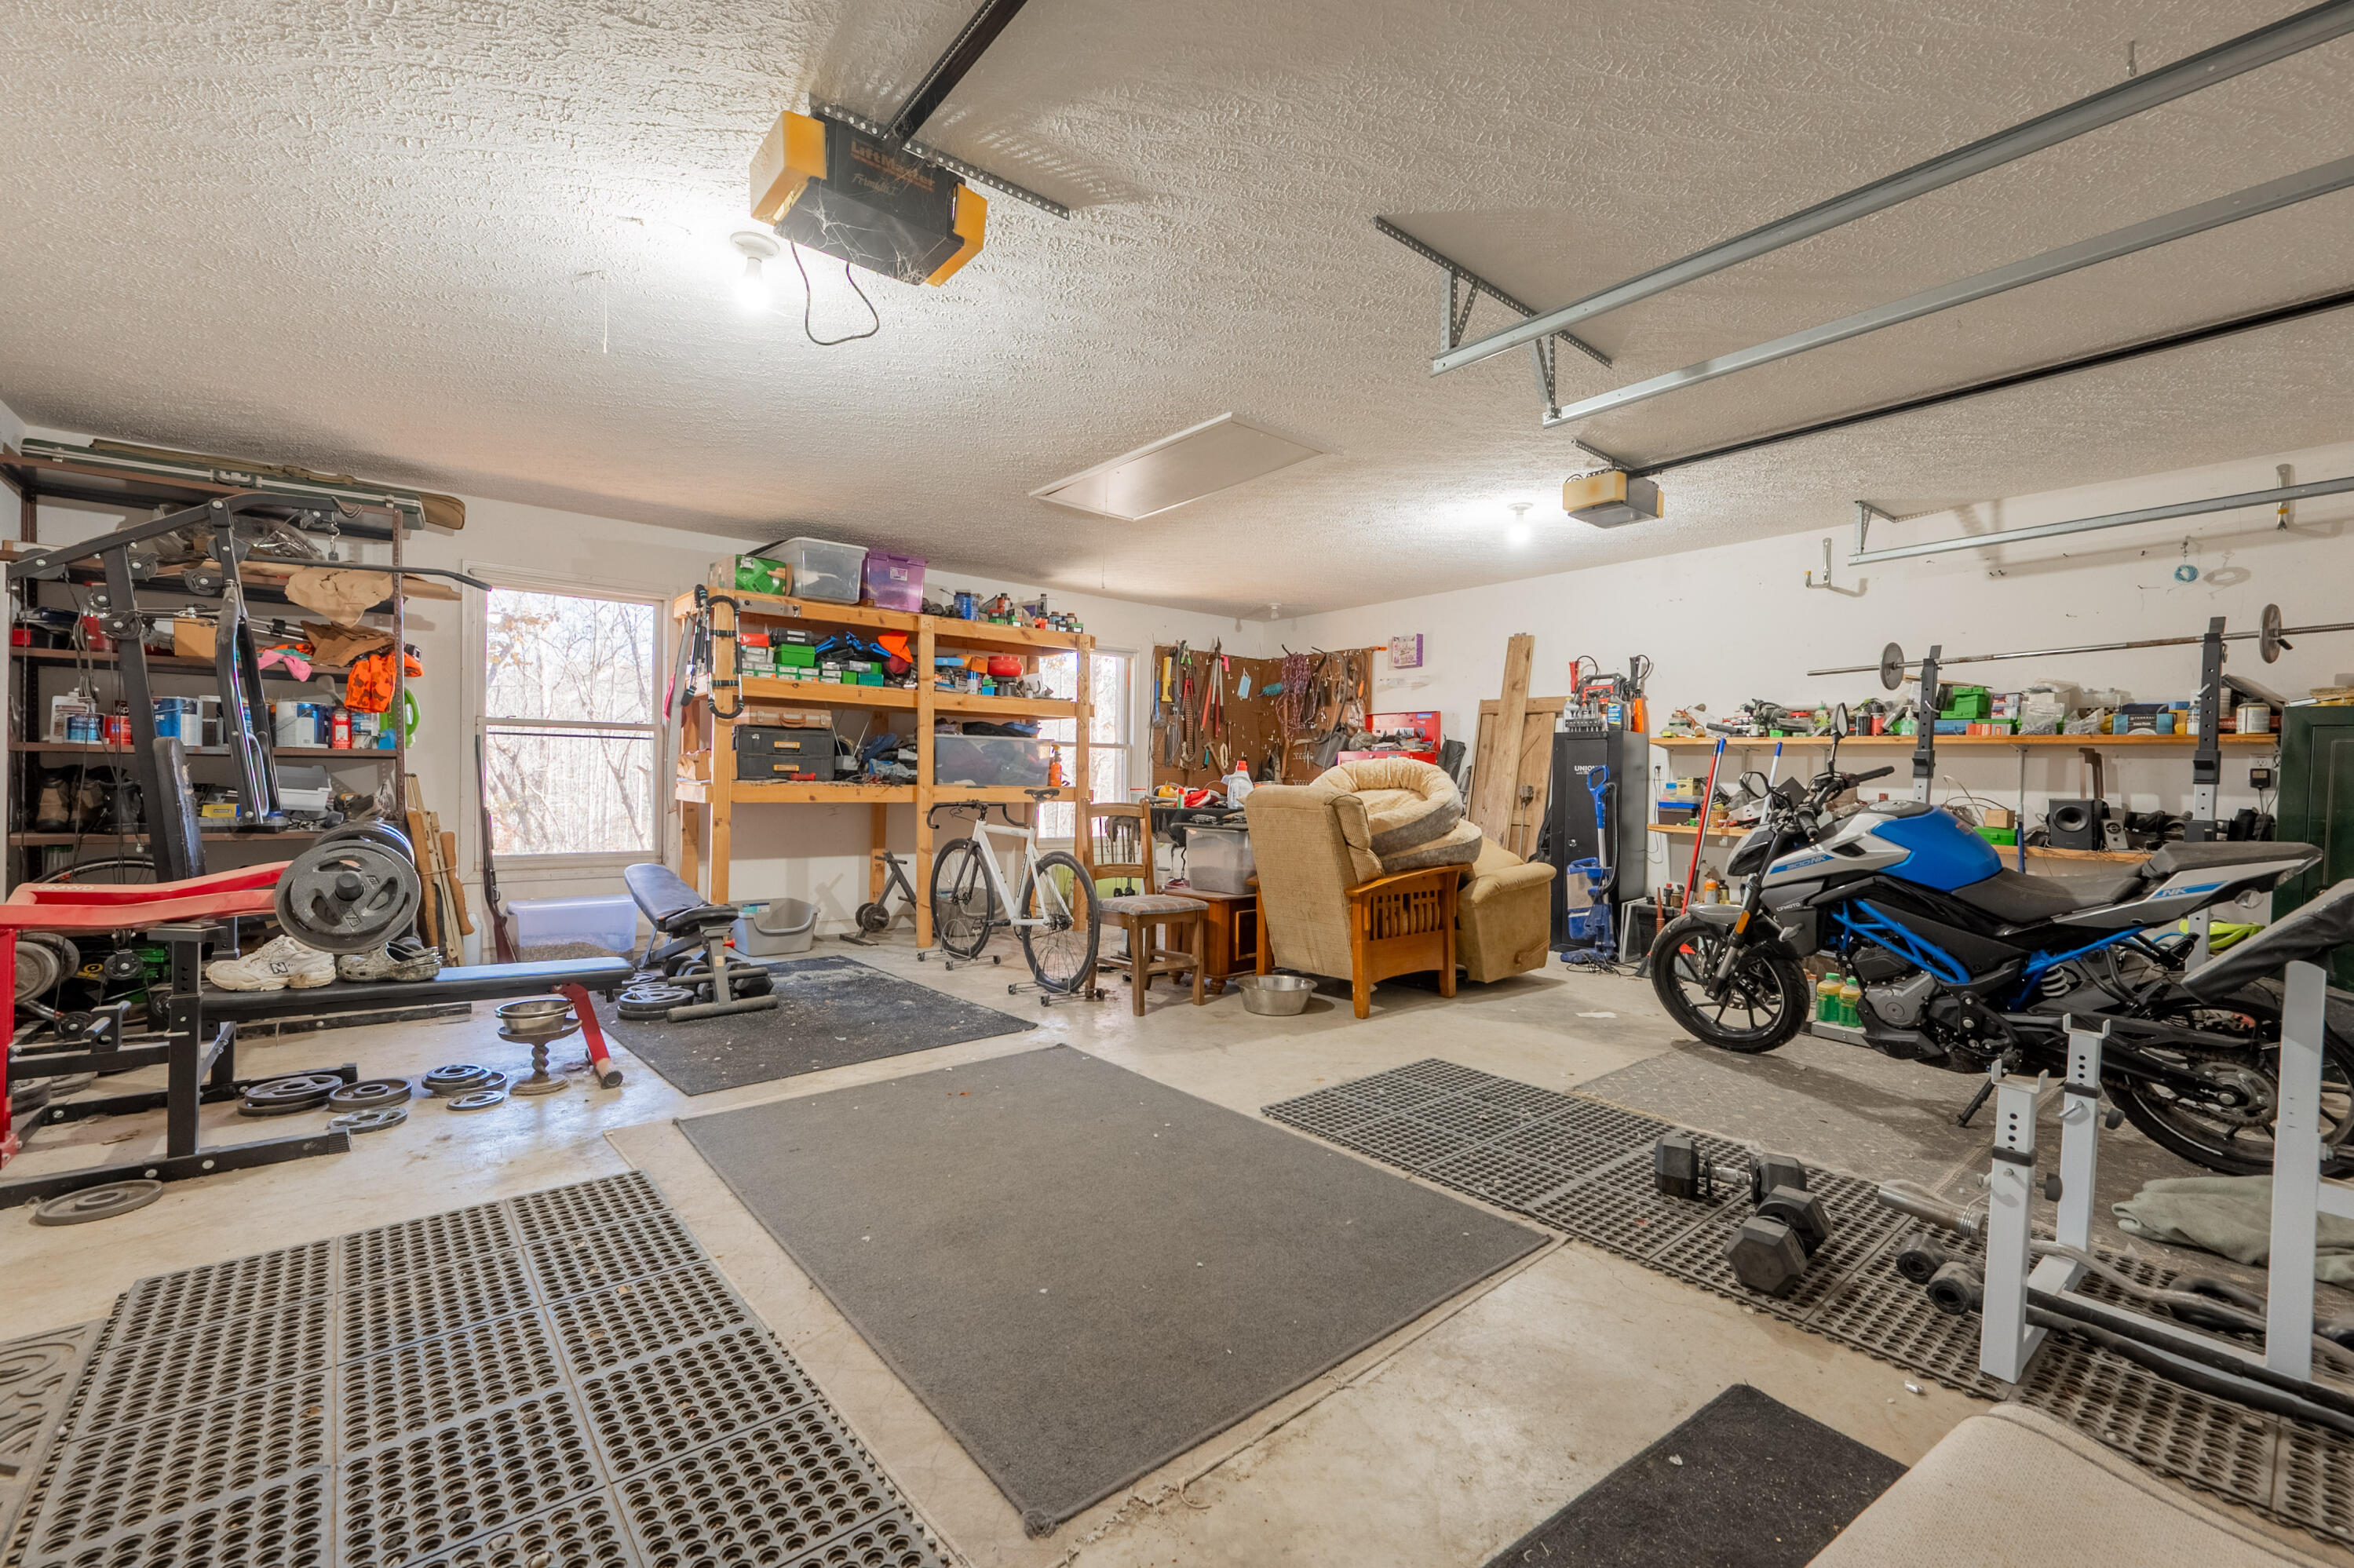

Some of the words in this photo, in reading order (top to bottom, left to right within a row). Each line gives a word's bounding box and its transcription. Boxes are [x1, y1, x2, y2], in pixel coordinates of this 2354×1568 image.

[850, 140, 936, 189] LiftMaster
[2162, 888, 2186, 897] NK
[1776, 902, 1801, 911] CFMOTO
